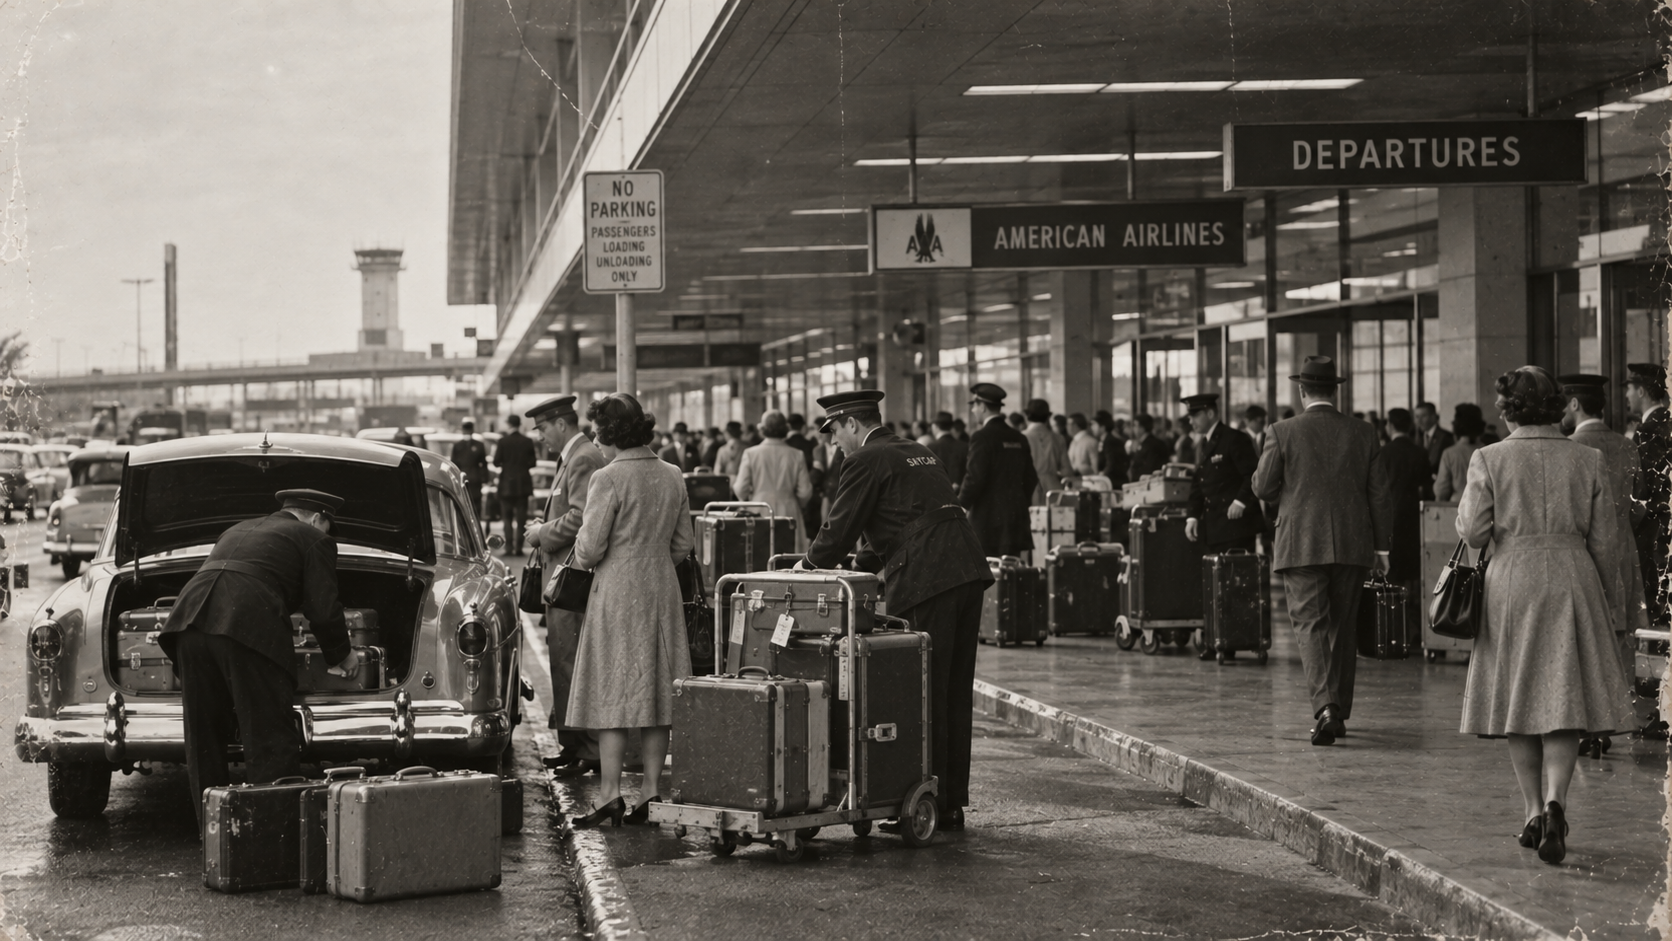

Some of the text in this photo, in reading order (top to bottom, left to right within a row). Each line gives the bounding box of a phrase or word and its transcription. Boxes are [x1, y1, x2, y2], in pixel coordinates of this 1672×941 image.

[1292, 136, 1521, 170] DEPARTURES
[612, 180, 634, 197] NO
[591, 200, 656, 218] PARKING
[591, 225, 656, 238] PASSENGERS
[994, 221, 1225, 250] AMERICAN AIRLINES
[603, 241, 645, 253] LOADING
[596, 255, 652, 268] UNLOADING
[611, 270, 637, 282] ONLY
